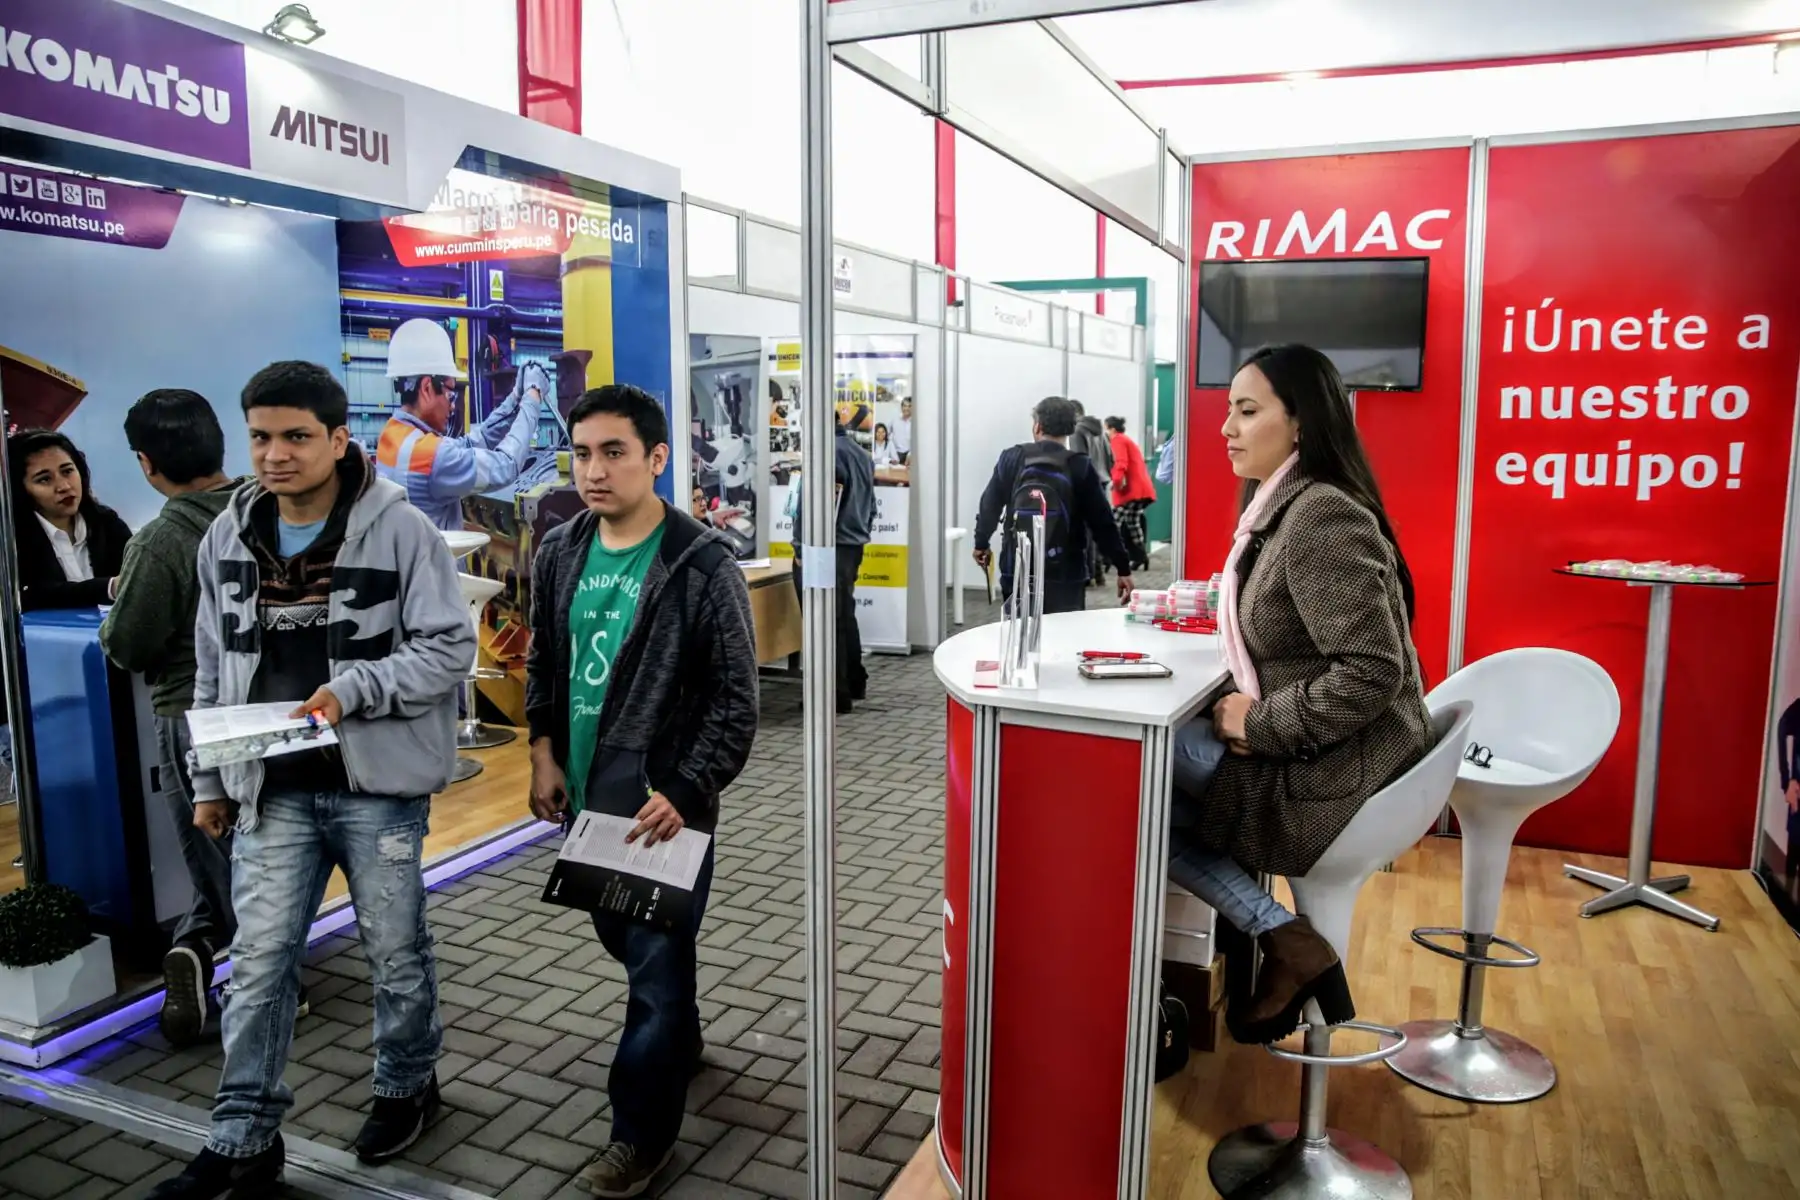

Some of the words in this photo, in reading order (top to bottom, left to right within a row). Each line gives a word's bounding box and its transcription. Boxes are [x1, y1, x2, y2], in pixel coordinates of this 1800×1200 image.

[0, 26, 231, 124] KOMATSU
[270, 105, 389, 165] MITSUI
[415, 234, 553, 258] www.cumminsperu.pe
[565, 211, 634, 243] pesada
[1205, 207, 1451, 259] RIMAC
[1502, 297, 1708, 353] ¡Únete
[1737, 314, 1770, 349] a
[1500, 375, 1749, 420] nuestro
[1495, 439, 1745, 501] equipo!
[576, 574, 641, 604] ANDMAD
[584, 610, 597, 619] IN
[604, 610, 621, 620] THE
